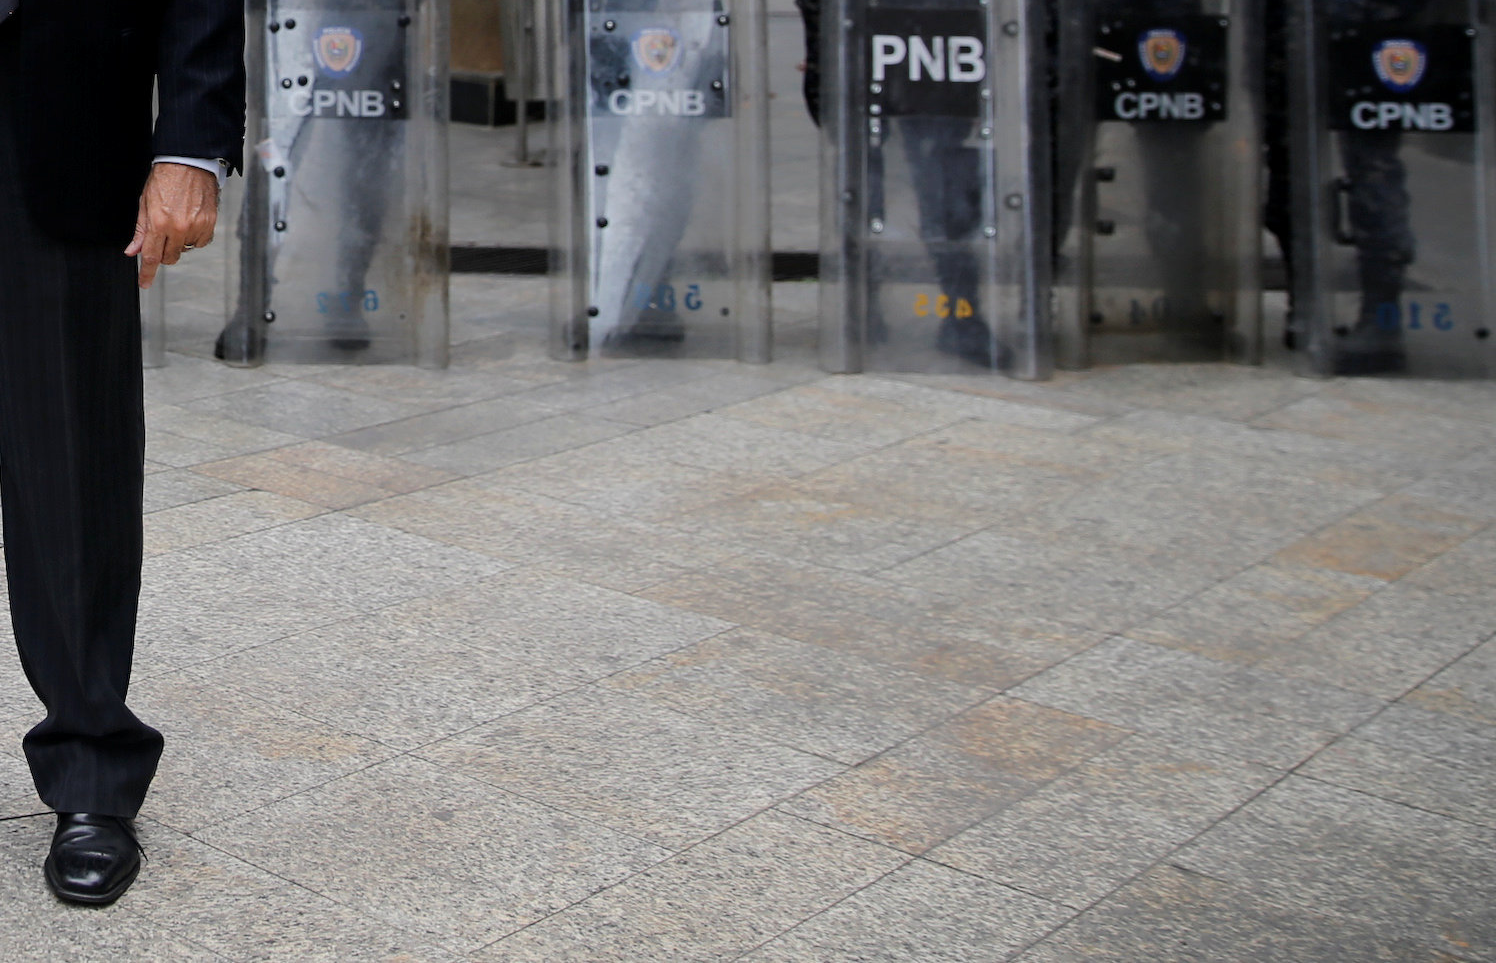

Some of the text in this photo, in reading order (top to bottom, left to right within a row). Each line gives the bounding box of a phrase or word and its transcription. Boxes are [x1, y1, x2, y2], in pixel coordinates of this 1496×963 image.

[872, 34, 986, 83] PNB
[288, 89, 385, 118] CPNB
[607, 88, 706, 116] CPNB
[1114, 92, 1205, 119] CPNB
[1350, 101, 1454, 130] CPNB
